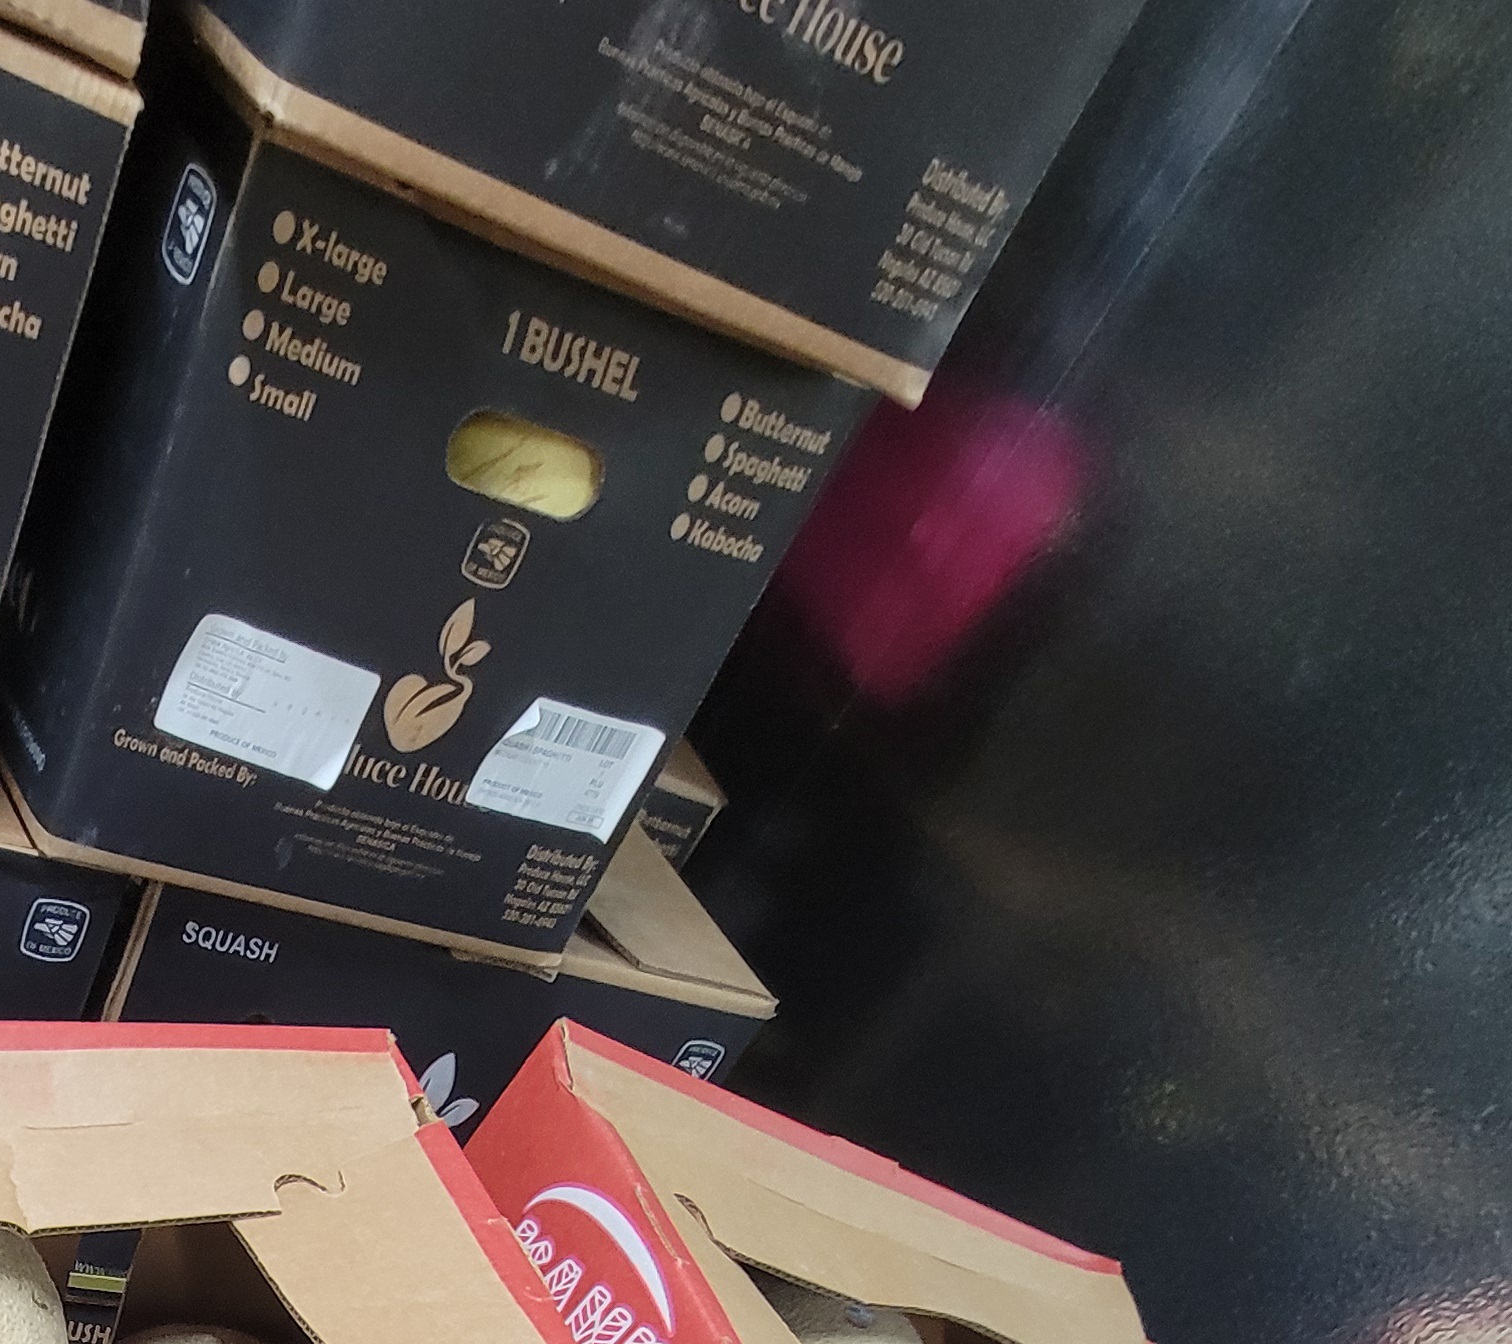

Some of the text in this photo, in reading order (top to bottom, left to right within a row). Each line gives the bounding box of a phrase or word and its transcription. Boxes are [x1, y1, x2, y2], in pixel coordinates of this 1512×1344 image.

[295, 218, 388, 286] X-large
[280, 269, 352, 327] Large
[264, 320, 362, 387] Medium
[501, 309, 641, 402] 1 BUSHEL
[248, 373, 318, 422] Small
[737, 398, 832, 455] Butternut
[721, 441, 812, 493] Spaghetti
[704, 481, 761, 521] Acorn
[687, 517, 765, 563] Kabocha
[113, 727, 260, 789] Grown and Packed By:
[182, 920, 279, 963] SQUASH
